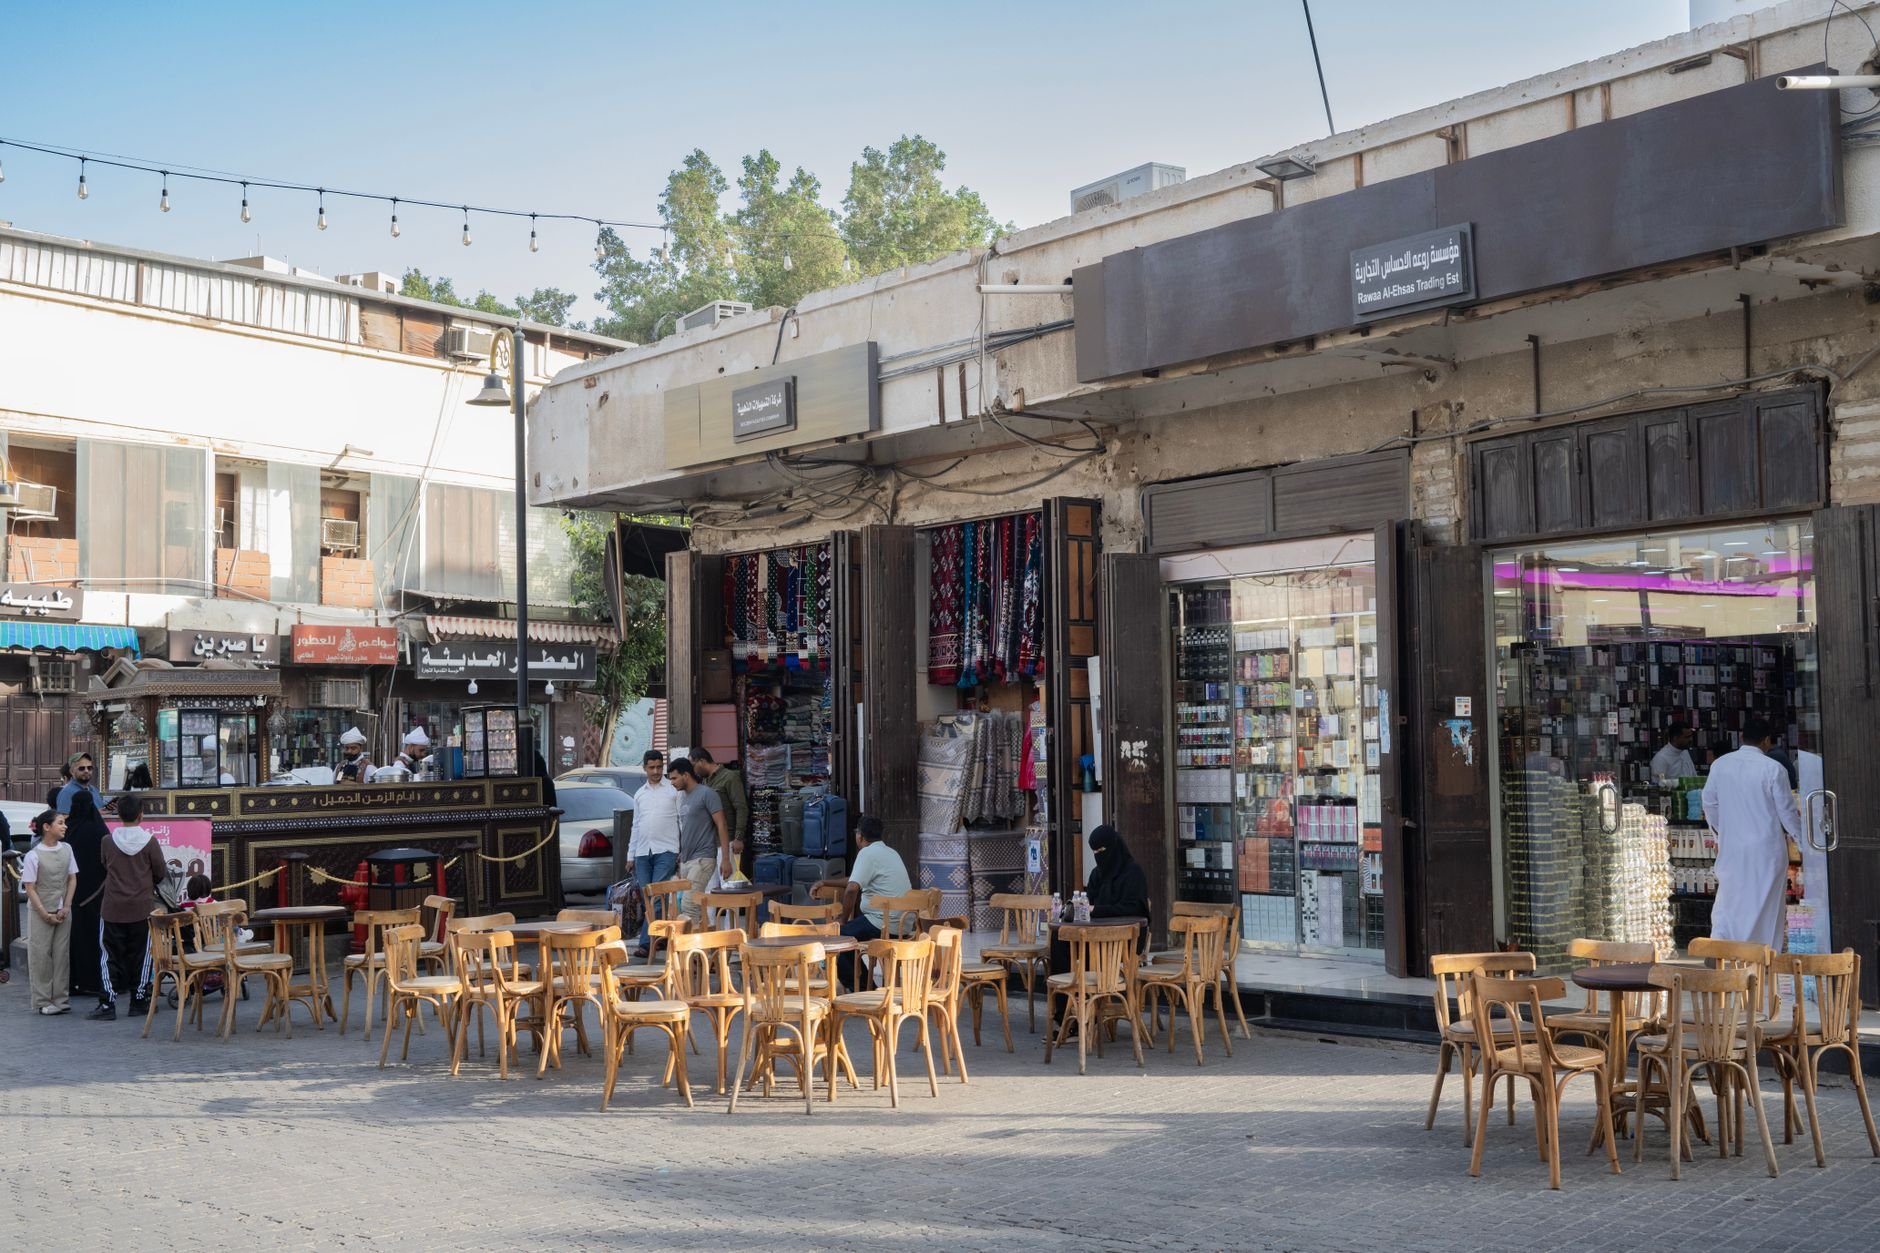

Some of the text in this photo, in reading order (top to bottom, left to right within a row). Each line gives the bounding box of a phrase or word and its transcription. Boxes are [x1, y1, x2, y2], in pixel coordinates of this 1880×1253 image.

[1430, 238, 1460, 264] مؤسسة
[1355, 257, 1380, 284] التجارية
[1357, 272, 1460, 305] Rawaa Al-Ehsas Trading Est
[296, 634, 396, 648] نواعم للعطور
[421, 647, 506, 671] الحديثة
[319, 792, 361, 807] الجميل
[362, 792, 395, 805] الزمن
